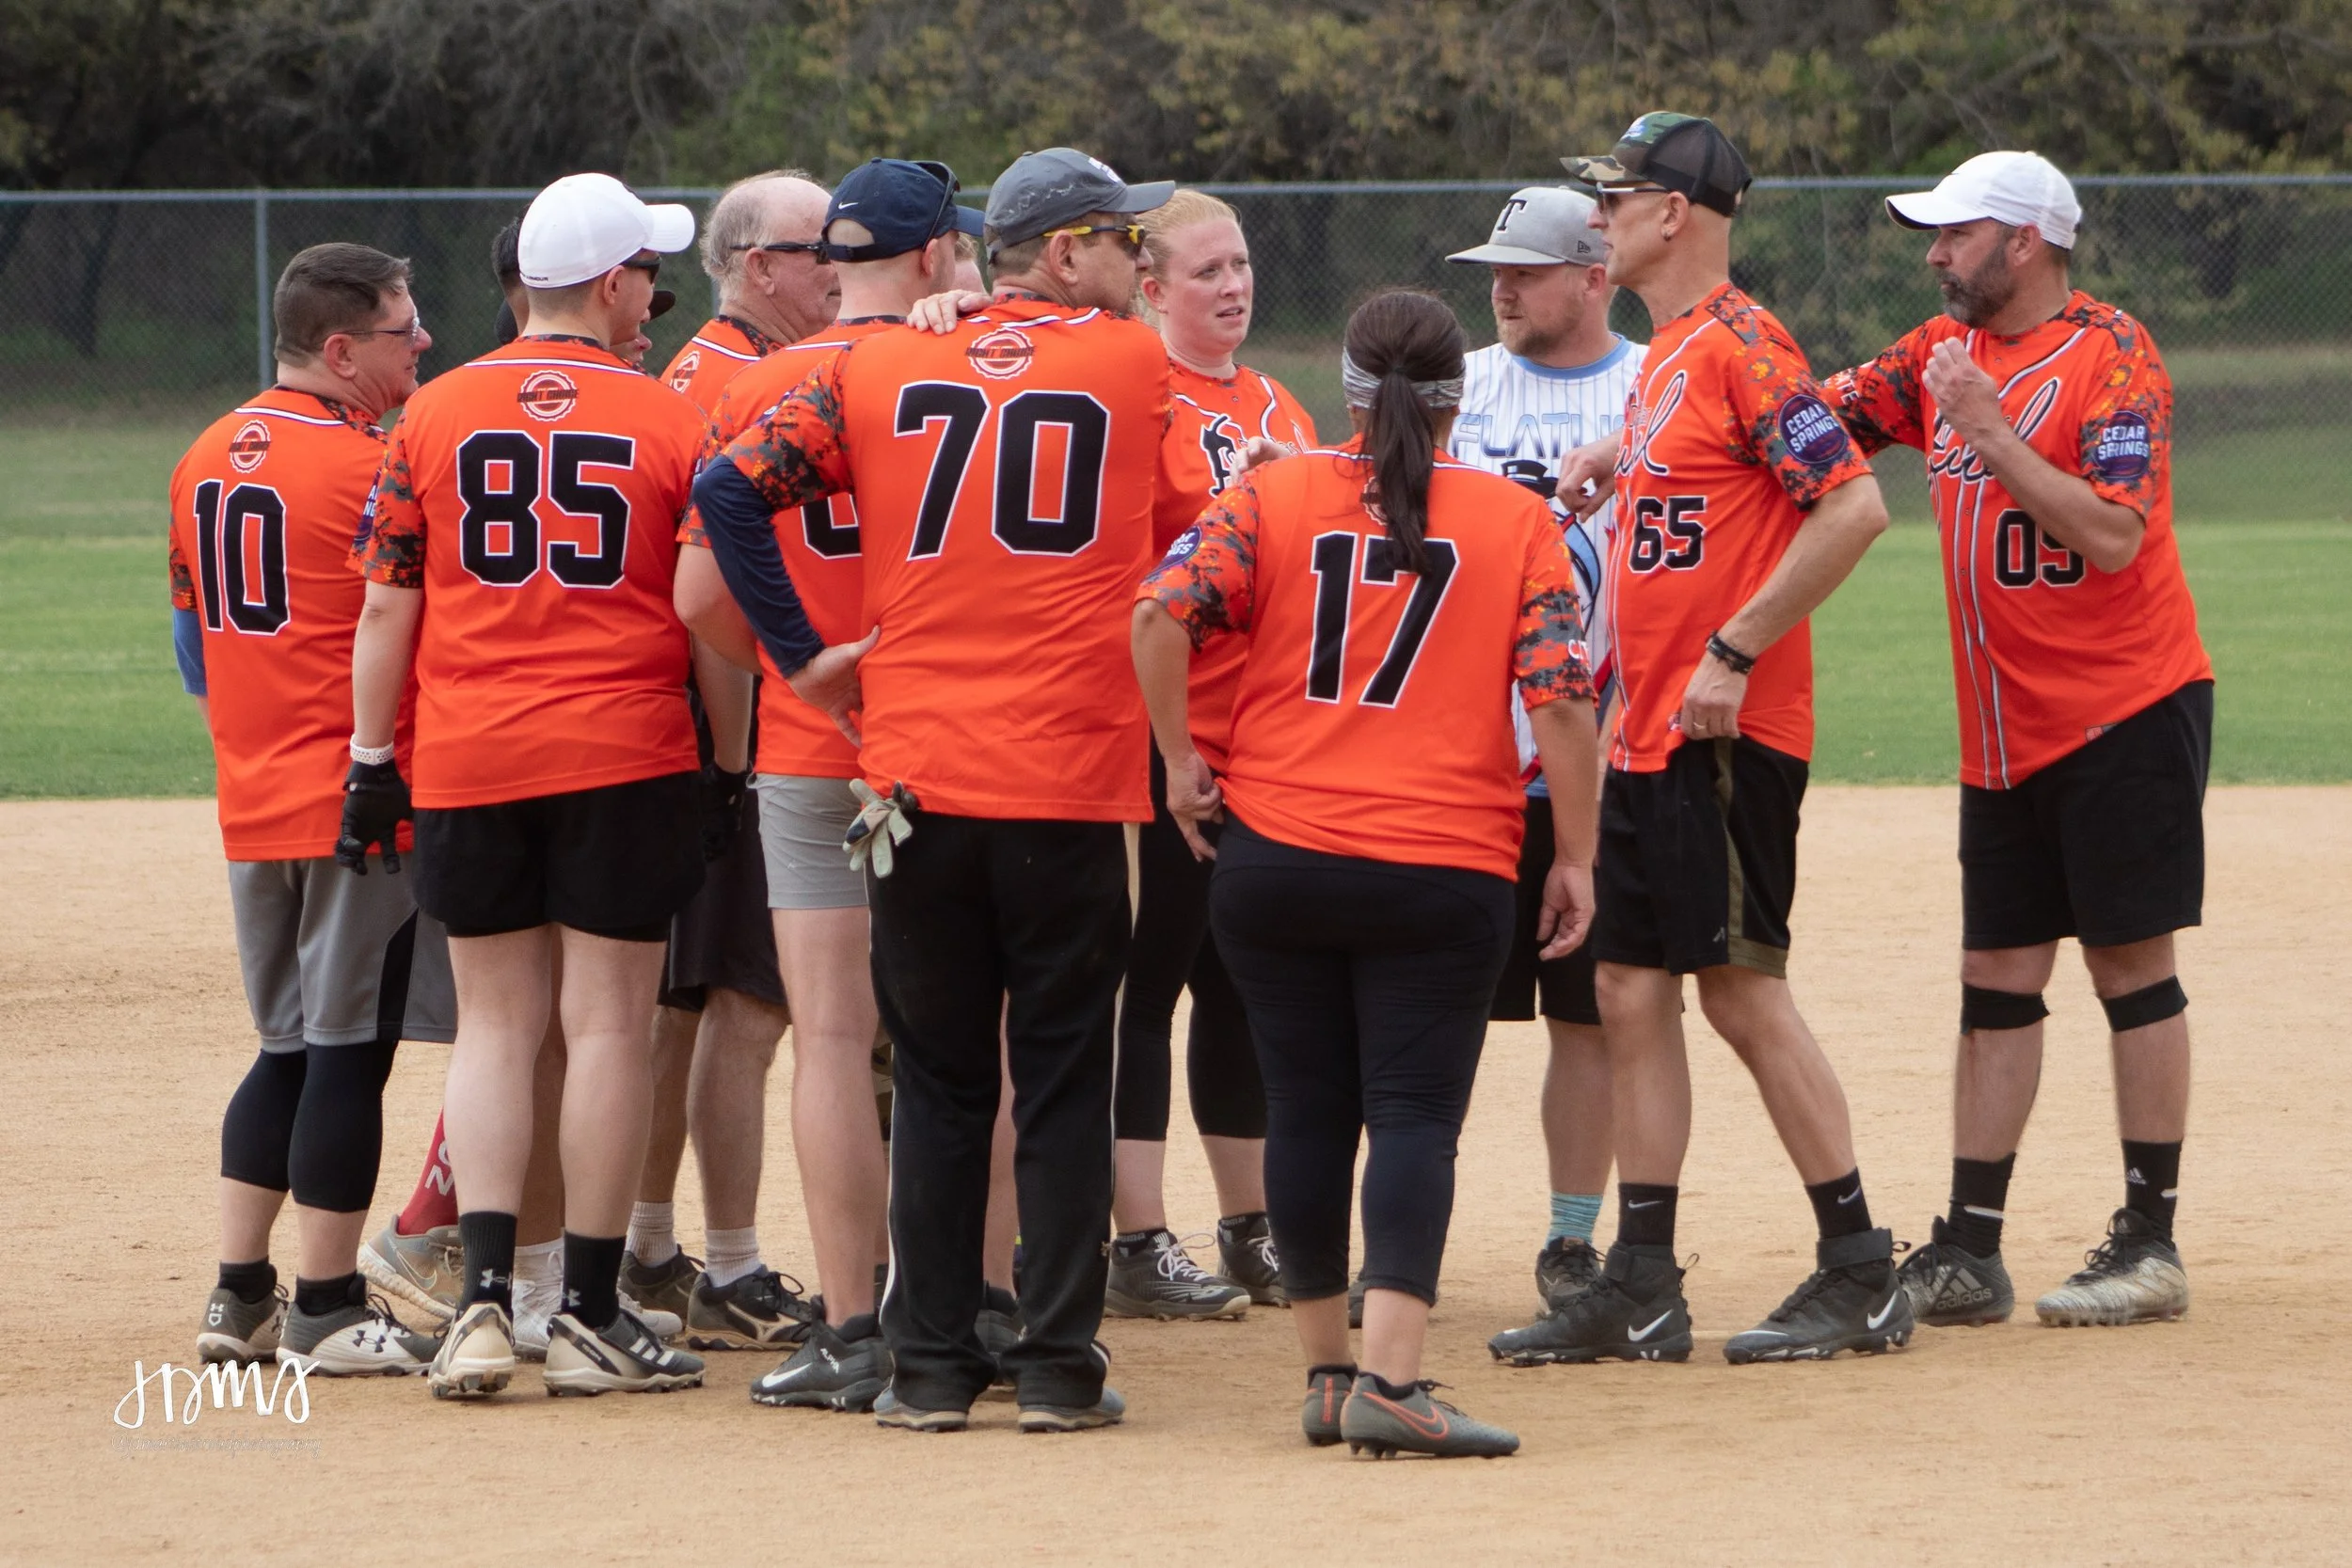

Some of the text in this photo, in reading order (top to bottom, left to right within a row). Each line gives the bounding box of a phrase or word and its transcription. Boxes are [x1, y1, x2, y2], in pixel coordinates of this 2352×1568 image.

[1497, 198, 1528, 233] T
[1789, 415, 1840, 452] SPRINGS
[2097, 441, 2150, 461] SPRINGS
[2103, 425, 2145, 443] CEDAR
[894, 380, 1111, 562] 70
[456, 430, 636, 589] 85
[1628, 495, 1708, 574] 65
[193, 478, 291, 636] 10
[1305, 531, 1460, 708] 17
[1937, 1287, 1993, 1310] adidas
